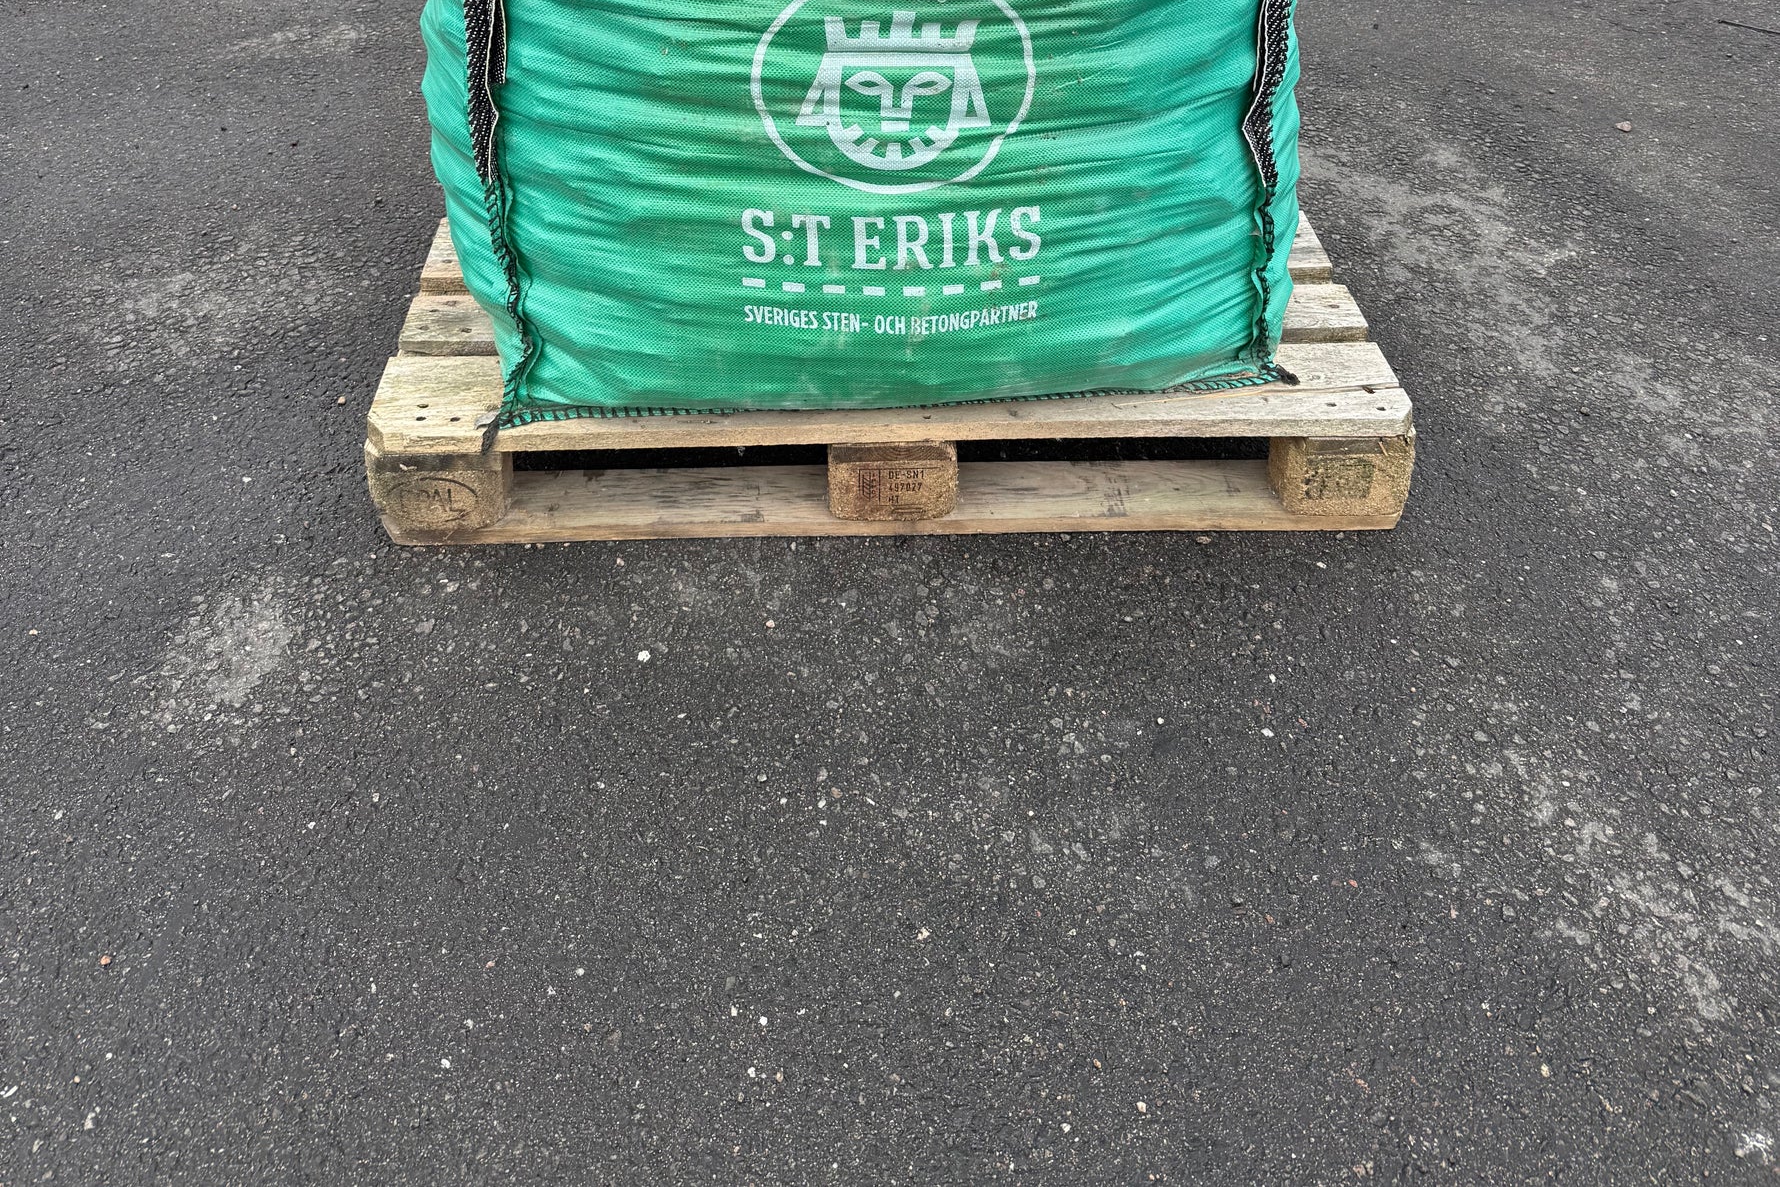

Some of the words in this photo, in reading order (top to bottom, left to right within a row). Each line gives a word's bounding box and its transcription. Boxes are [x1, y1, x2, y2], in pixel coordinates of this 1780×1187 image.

[741, 208, 831, 267] S:T
[851, 205, 1042, 270] ERIKS
[744, 304, 819, 329] SVERIGES
[822, 311, 869, 333] STEN-
[874, 314, 906, 335] OCH
[910, 300, 1039, 336] BETONGPARTNER
